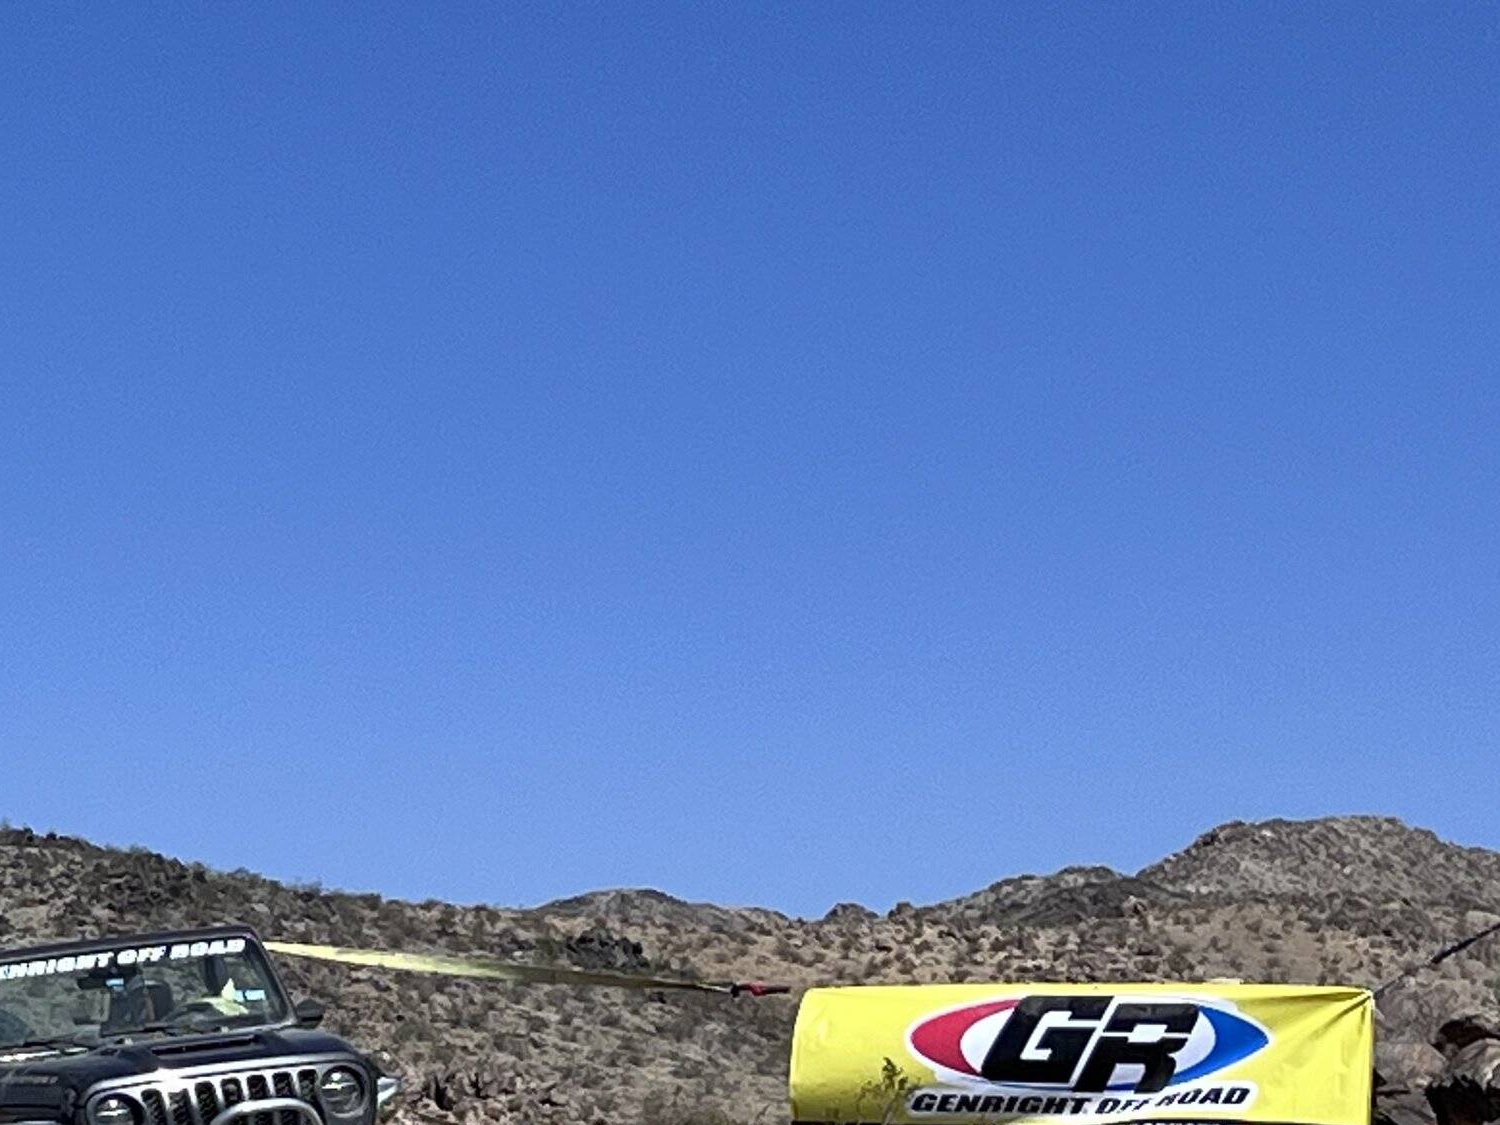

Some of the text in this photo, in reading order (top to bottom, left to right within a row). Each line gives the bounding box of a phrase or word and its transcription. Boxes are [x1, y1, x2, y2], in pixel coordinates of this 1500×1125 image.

[116, 946, 167, 965] OFF
[169, 939, 246, 960] ROAD
[980, 995, 1200, 1093] GR
[910, 1093, 1095, 1115] GENRIGHT
[1095, 1097, 1152, 1114] OFF
